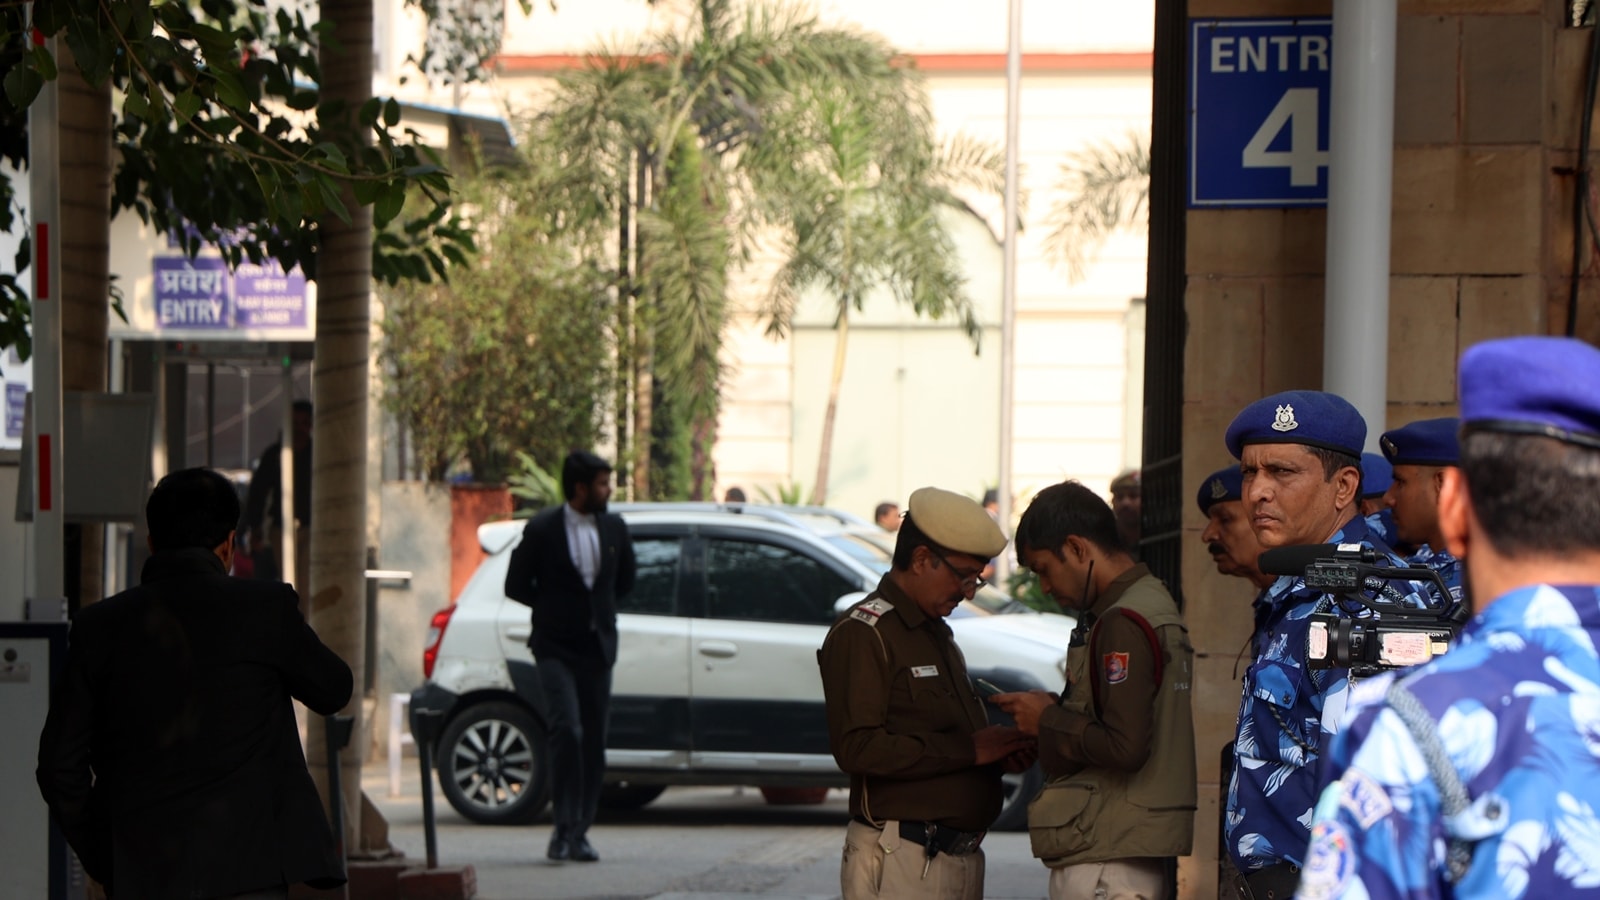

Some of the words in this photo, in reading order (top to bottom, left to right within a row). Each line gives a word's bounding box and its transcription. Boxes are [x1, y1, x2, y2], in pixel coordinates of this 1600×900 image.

[1210, 36, 1331, 72] ENTR
[1242, 87, 1329, 186] 4
[160, 262, 223, 295] प्रवेश
[160, 299, 222, 324] ENTRY
